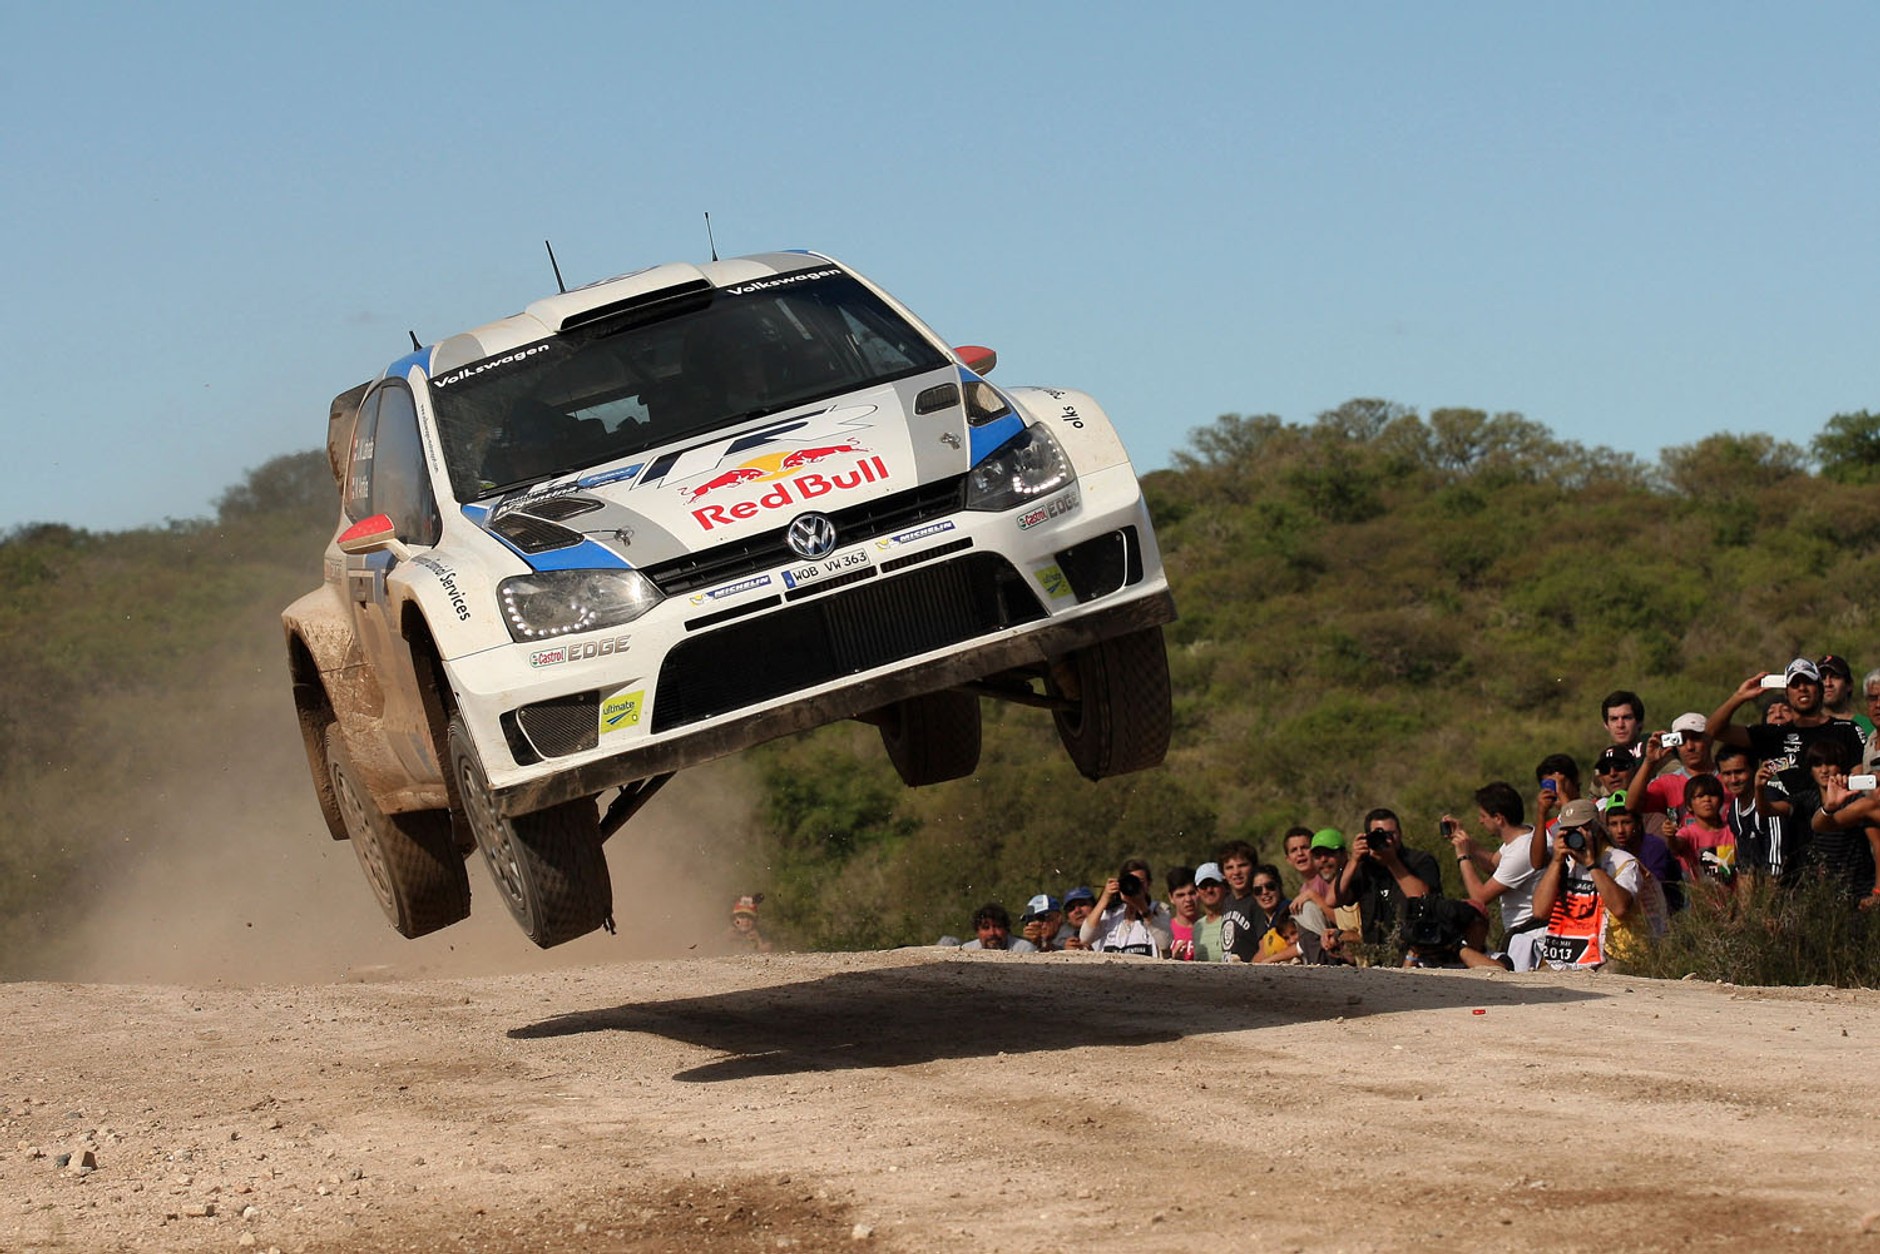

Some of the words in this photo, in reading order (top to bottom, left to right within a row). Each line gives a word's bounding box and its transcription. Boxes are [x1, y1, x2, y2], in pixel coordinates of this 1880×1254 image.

[726, 267, 842, 296] Volkswagen
[433, 343, 550, 388] Volkswagen
[691, 482, 794, 531] Red
[793, 455, 890, 500] Bull
[1047, 493, 1080, 519] EDGE
[899, 520, 955, 543] MICHELIN
[793, 566, 819, 583] WOB
[824, 559, 843, 573] VW
[843, 551, 868, 567] 363
[439, 572, 471, 621] Services
[713, 576, 770, 599] MICHELIN
[539, 649, 564, 665] Castrol
[567, 634, 632, 662] EDGE
[602, 700, 635, 716] ultimate
[1542, 946, 1573, 960] 2013
